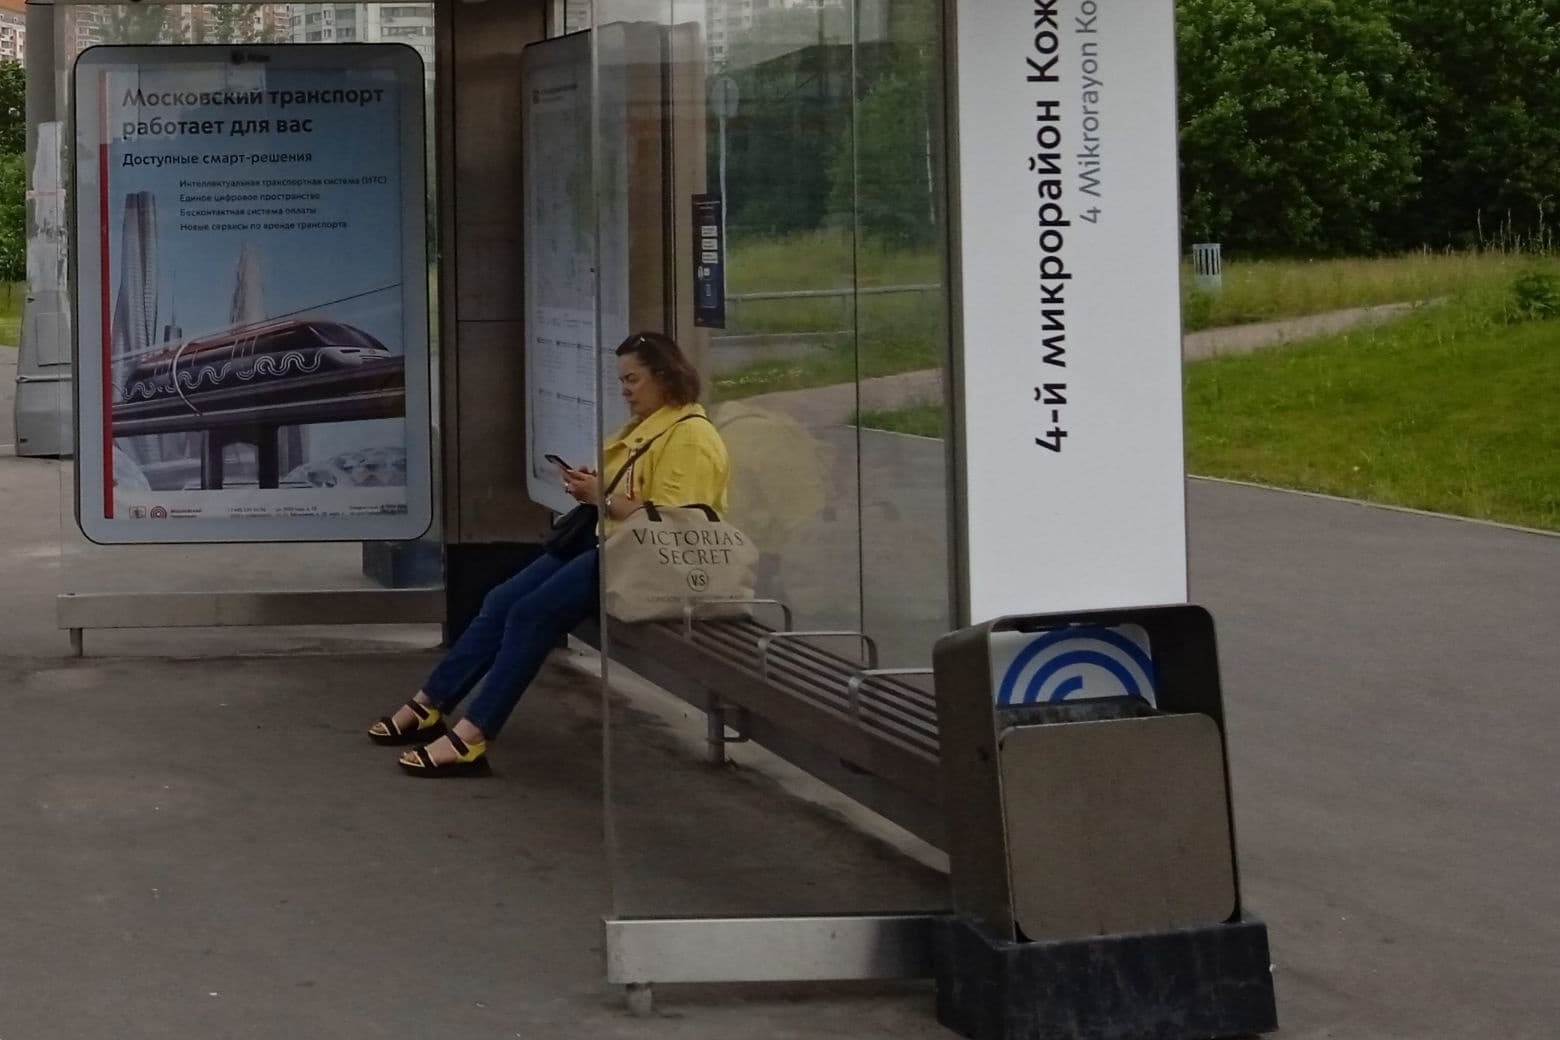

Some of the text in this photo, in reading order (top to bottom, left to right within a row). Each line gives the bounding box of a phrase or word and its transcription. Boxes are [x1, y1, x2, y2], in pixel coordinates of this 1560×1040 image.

[122, 88, 384, 108] Московский транспорт
[123, 117, 312, 139] работает для вас
[1077, 41, 1104, 197] Mikrorayon
[122, 151, 313, 167] Доступные смарт-решения
[1079, 206, 1102, 224] 4
[1028, 99, 1072, 368] микрорайон
[1035, 382, 1068, 453] 4-й
[659, 547, 732, 565] SECRET
